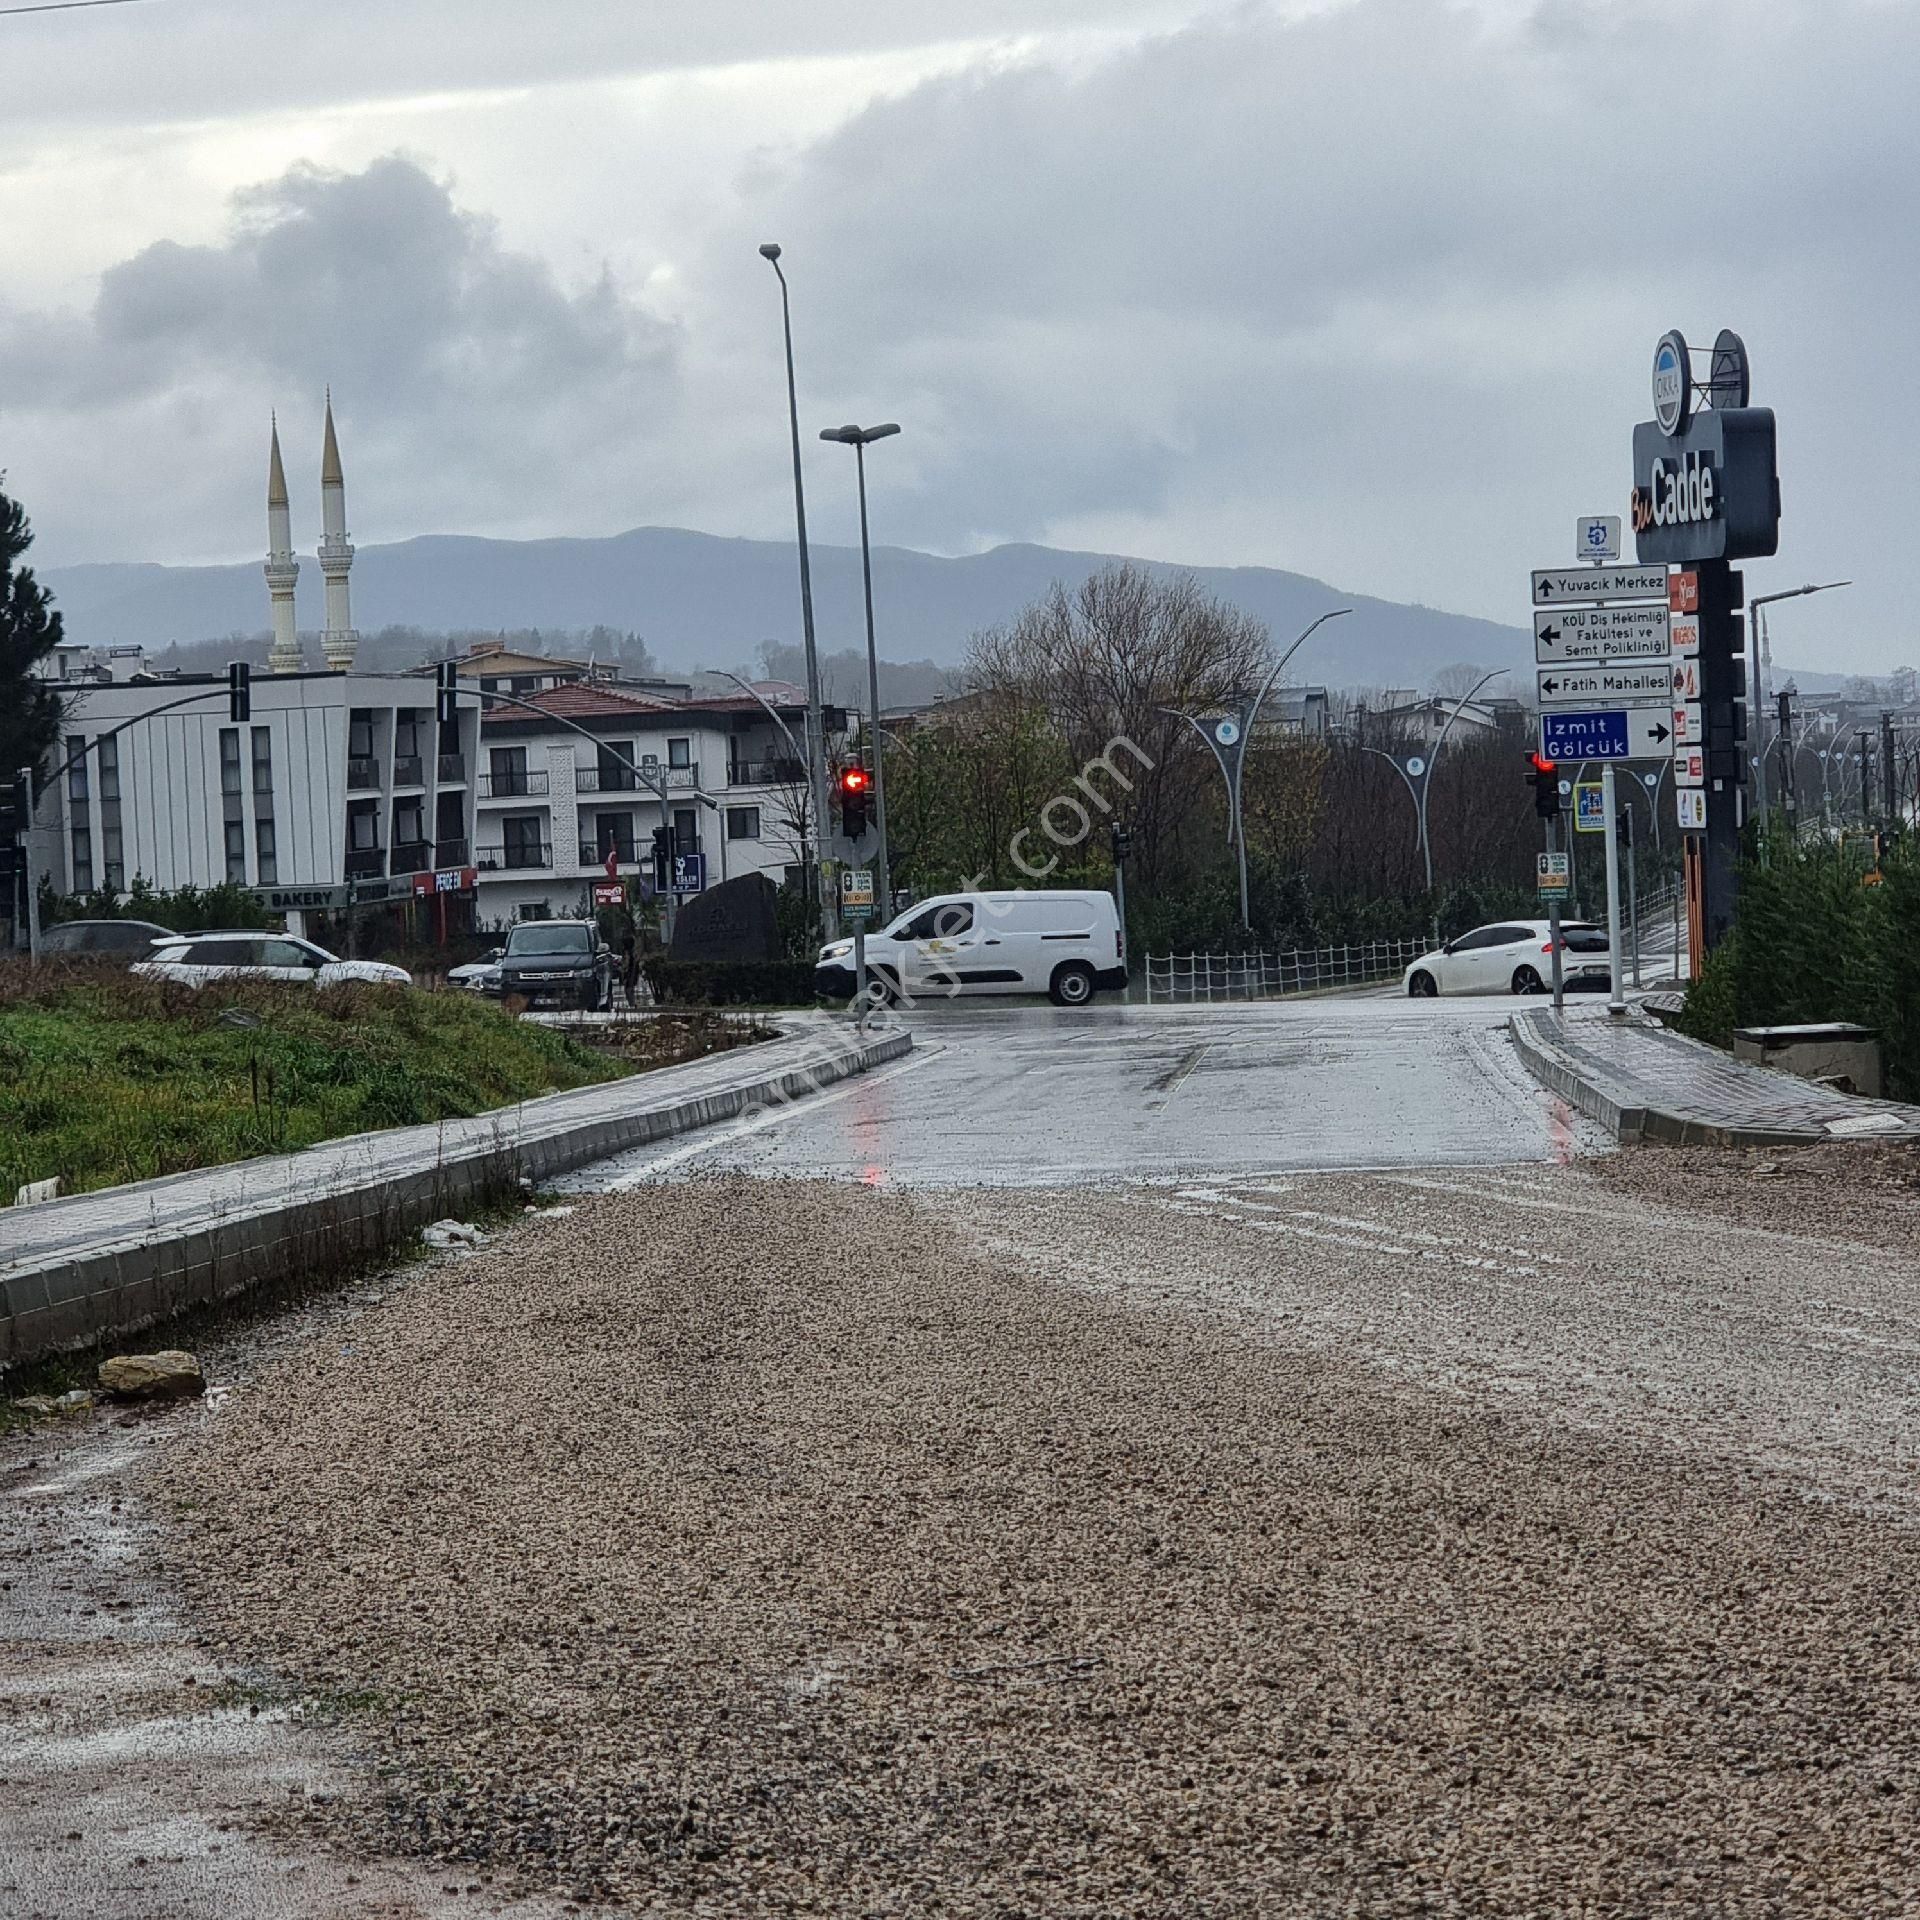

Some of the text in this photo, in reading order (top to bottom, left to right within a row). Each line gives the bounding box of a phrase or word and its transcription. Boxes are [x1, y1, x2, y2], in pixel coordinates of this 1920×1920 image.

[1652, 450, 1713, 526] Cadde
[1558, 575, 1664, 592] Yuvacık Merkez
[1562, 611, 1667, 627] KOÜ Diş Hekimliği
[1576, 628, 1653, 641] Fakültesi ve
[1564, 640, 1666, 656] Semt Polikliniği
[1562, 675, 1669, 691] Fatih Mahallesi
[1546, 716, 1607, 736] İzmit
[1547, 739, 1625, 757] Gölcük
[271, 890, 333, 908] BAKERY
